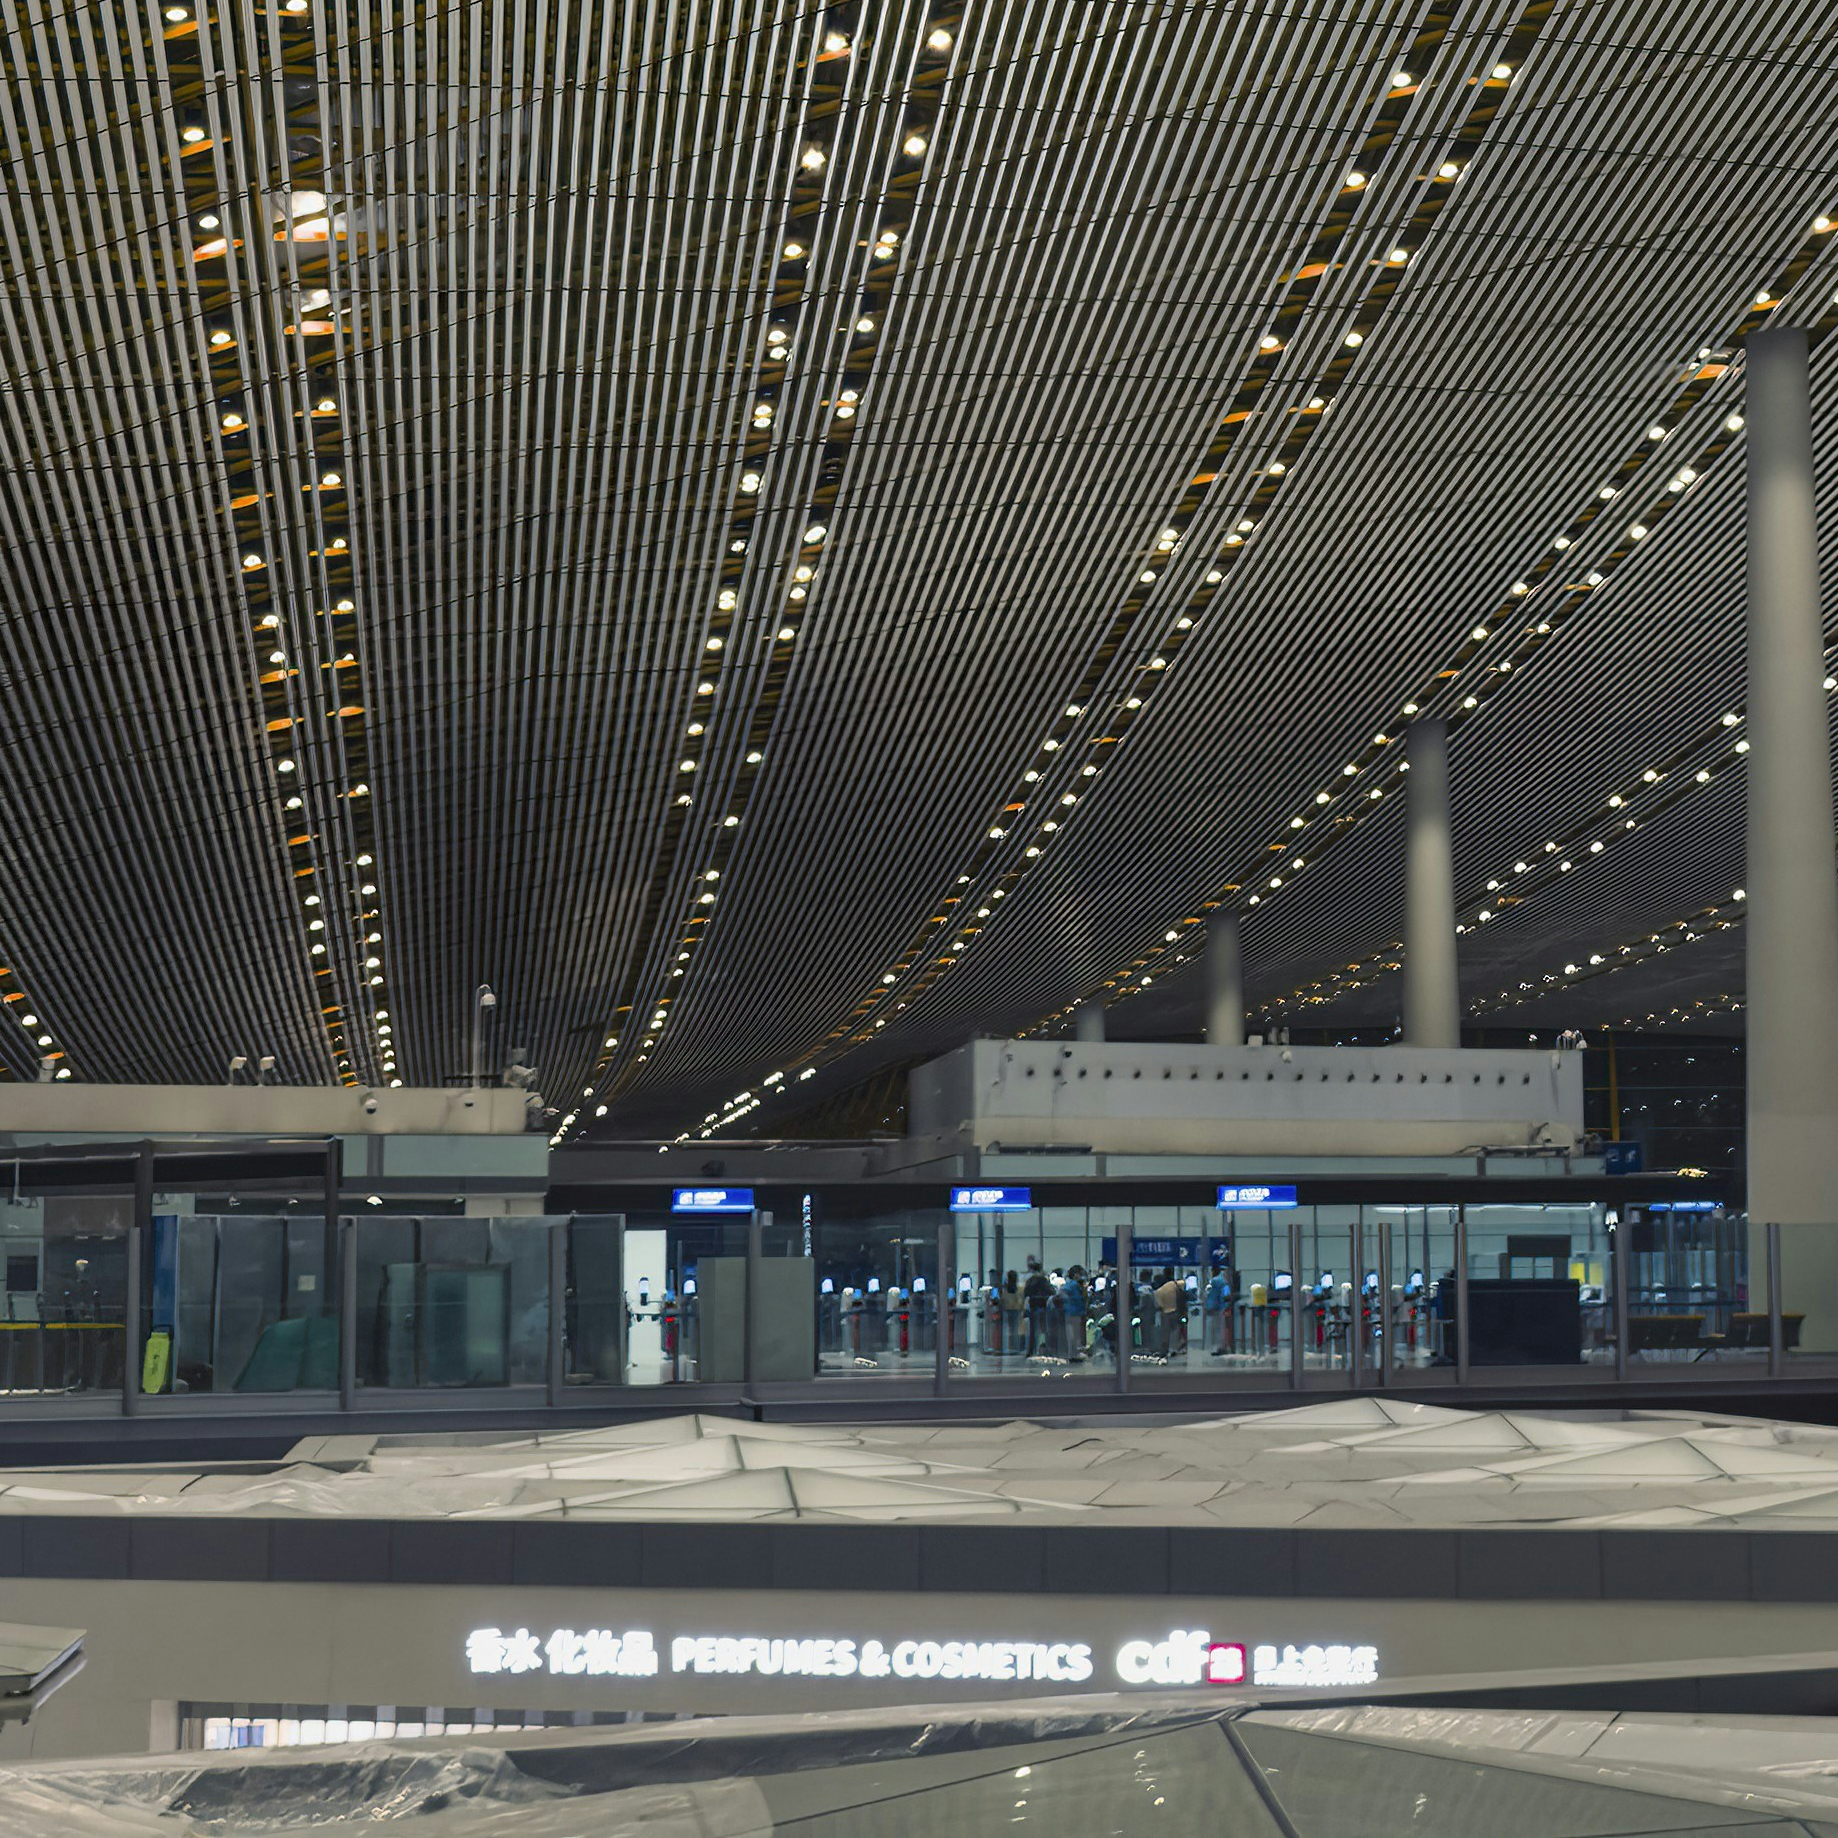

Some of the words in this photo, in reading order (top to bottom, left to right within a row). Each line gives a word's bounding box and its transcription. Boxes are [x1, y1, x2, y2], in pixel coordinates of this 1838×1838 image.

[465, 1627, 543, 1674] 香水
[544, 1628, 659, 1677] 化妆品
[671, 1636, 858, 1676] PERFUMES
[859, 1639, 891, 1677] &
[891, 1640, 1094, 1682] COSMETICS
[1115, 1629, 1212, 1685] cdf
